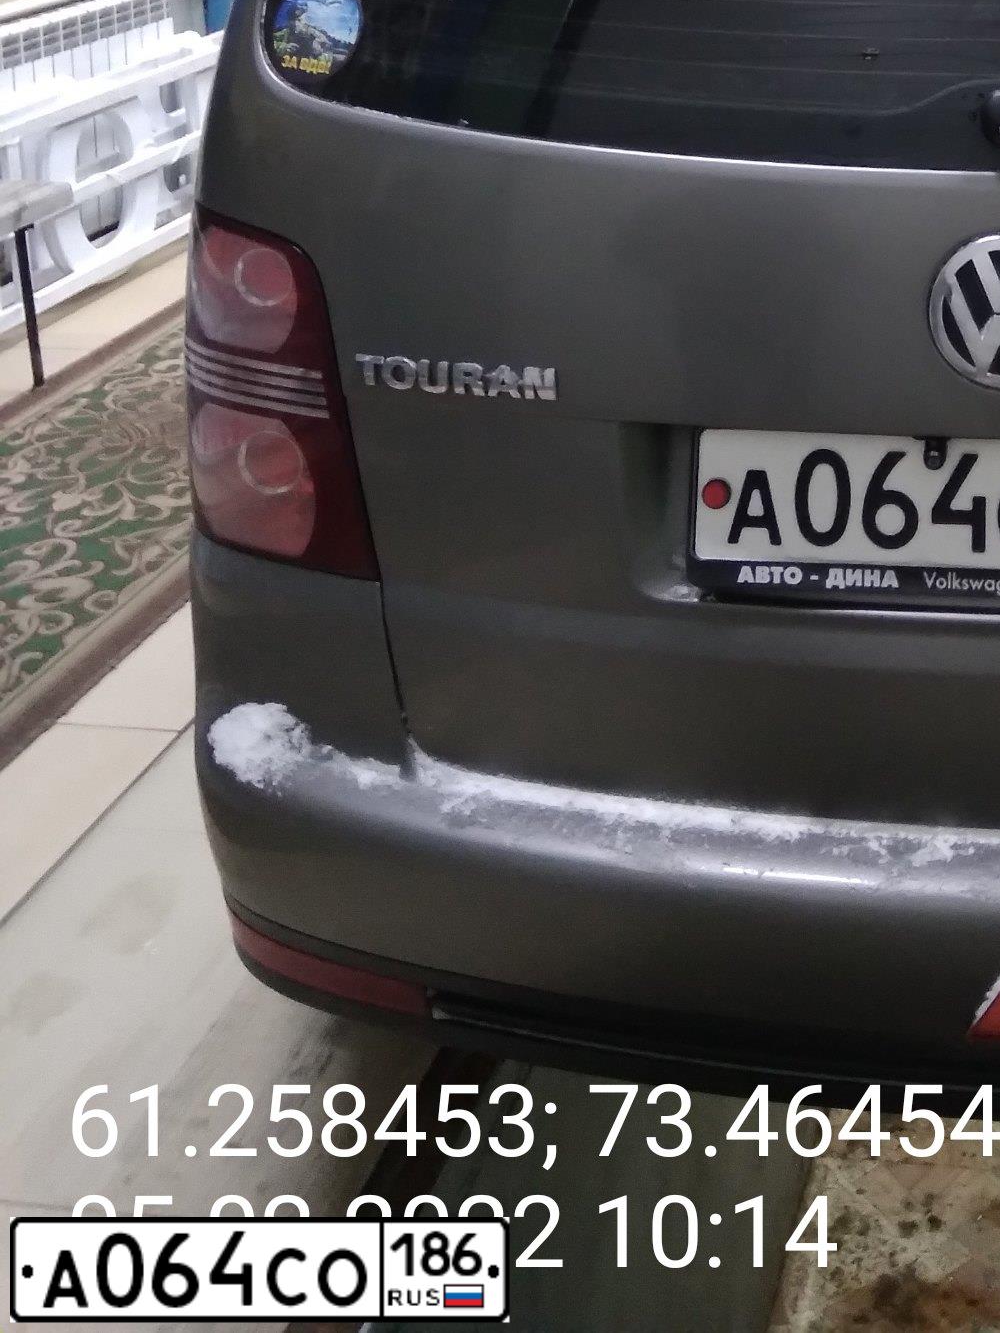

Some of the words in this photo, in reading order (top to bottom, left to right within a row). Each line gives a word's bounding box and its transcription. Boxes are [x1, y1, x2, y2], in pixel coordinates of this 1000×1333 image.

[355, 353, 557, 401] TOURAN
[736, 565, 803, 585] АВТО
[825, 568, 899, 589] ДИНА
